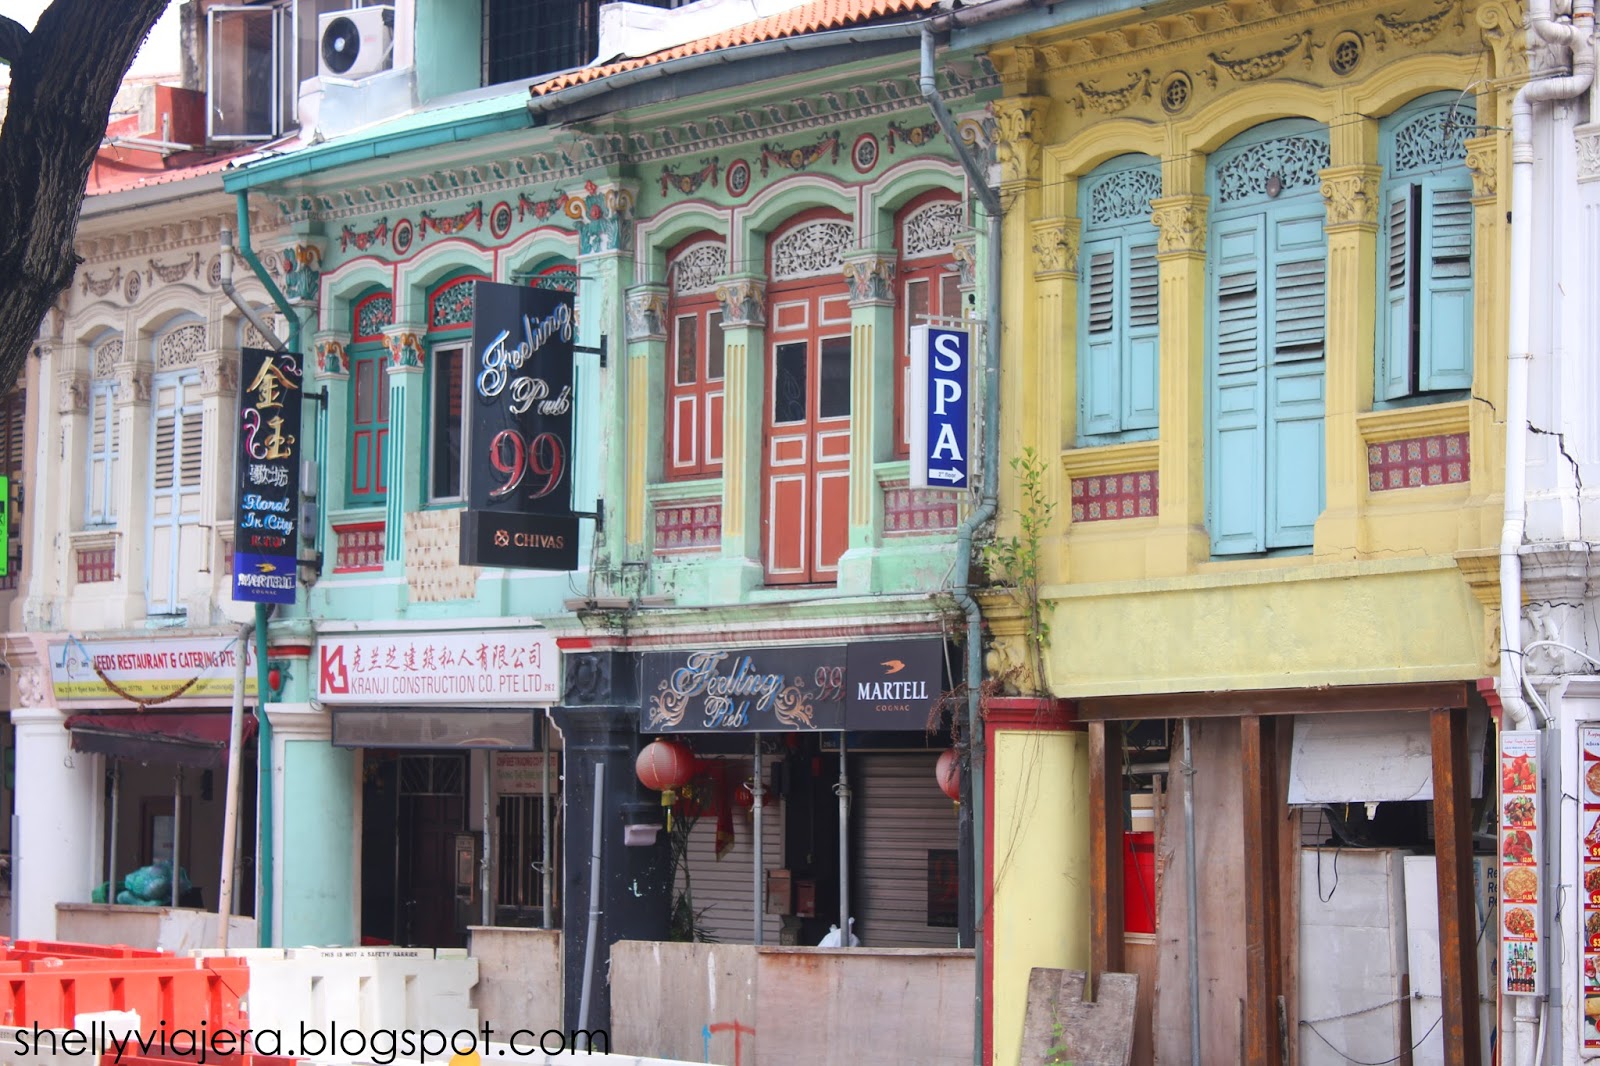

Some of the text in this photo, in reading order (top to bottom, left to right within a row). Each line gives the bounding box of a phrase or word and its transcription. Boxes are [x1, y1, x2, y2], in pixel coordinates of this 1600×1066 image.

[477, 302, 571, 397] Feeling
[509, 377, 571, 415] Pub
[931, 334, 963, 461] SPA
[489, 429, 566, 499] 99
[241, 493, 290, 512] Floral
[241, 513, 294, 535] In City
[514, 533, 564, 549] CHIVAS
[237, 573, 295, 589] MARTELL
[117, 652, 168, 670] RESTAURANT
[170, 652, 176, 667] &
[179, 651, 218, 669] CATERING
[351, 676, 390, 694] KRANJI
[393, 675, 475, 693] CONSTRUCTION
[478, 675, 496, 693] CO.
[499, 675, 519, 692] PTE
[522, 674, 542, 692] LTD
[671, 651, 847, 711] Feeling 99
[857, 681, 928, 700] MARTELL
[703, 695, 750, 728] Pub
[876, 704, 910, 712] COGNAC
